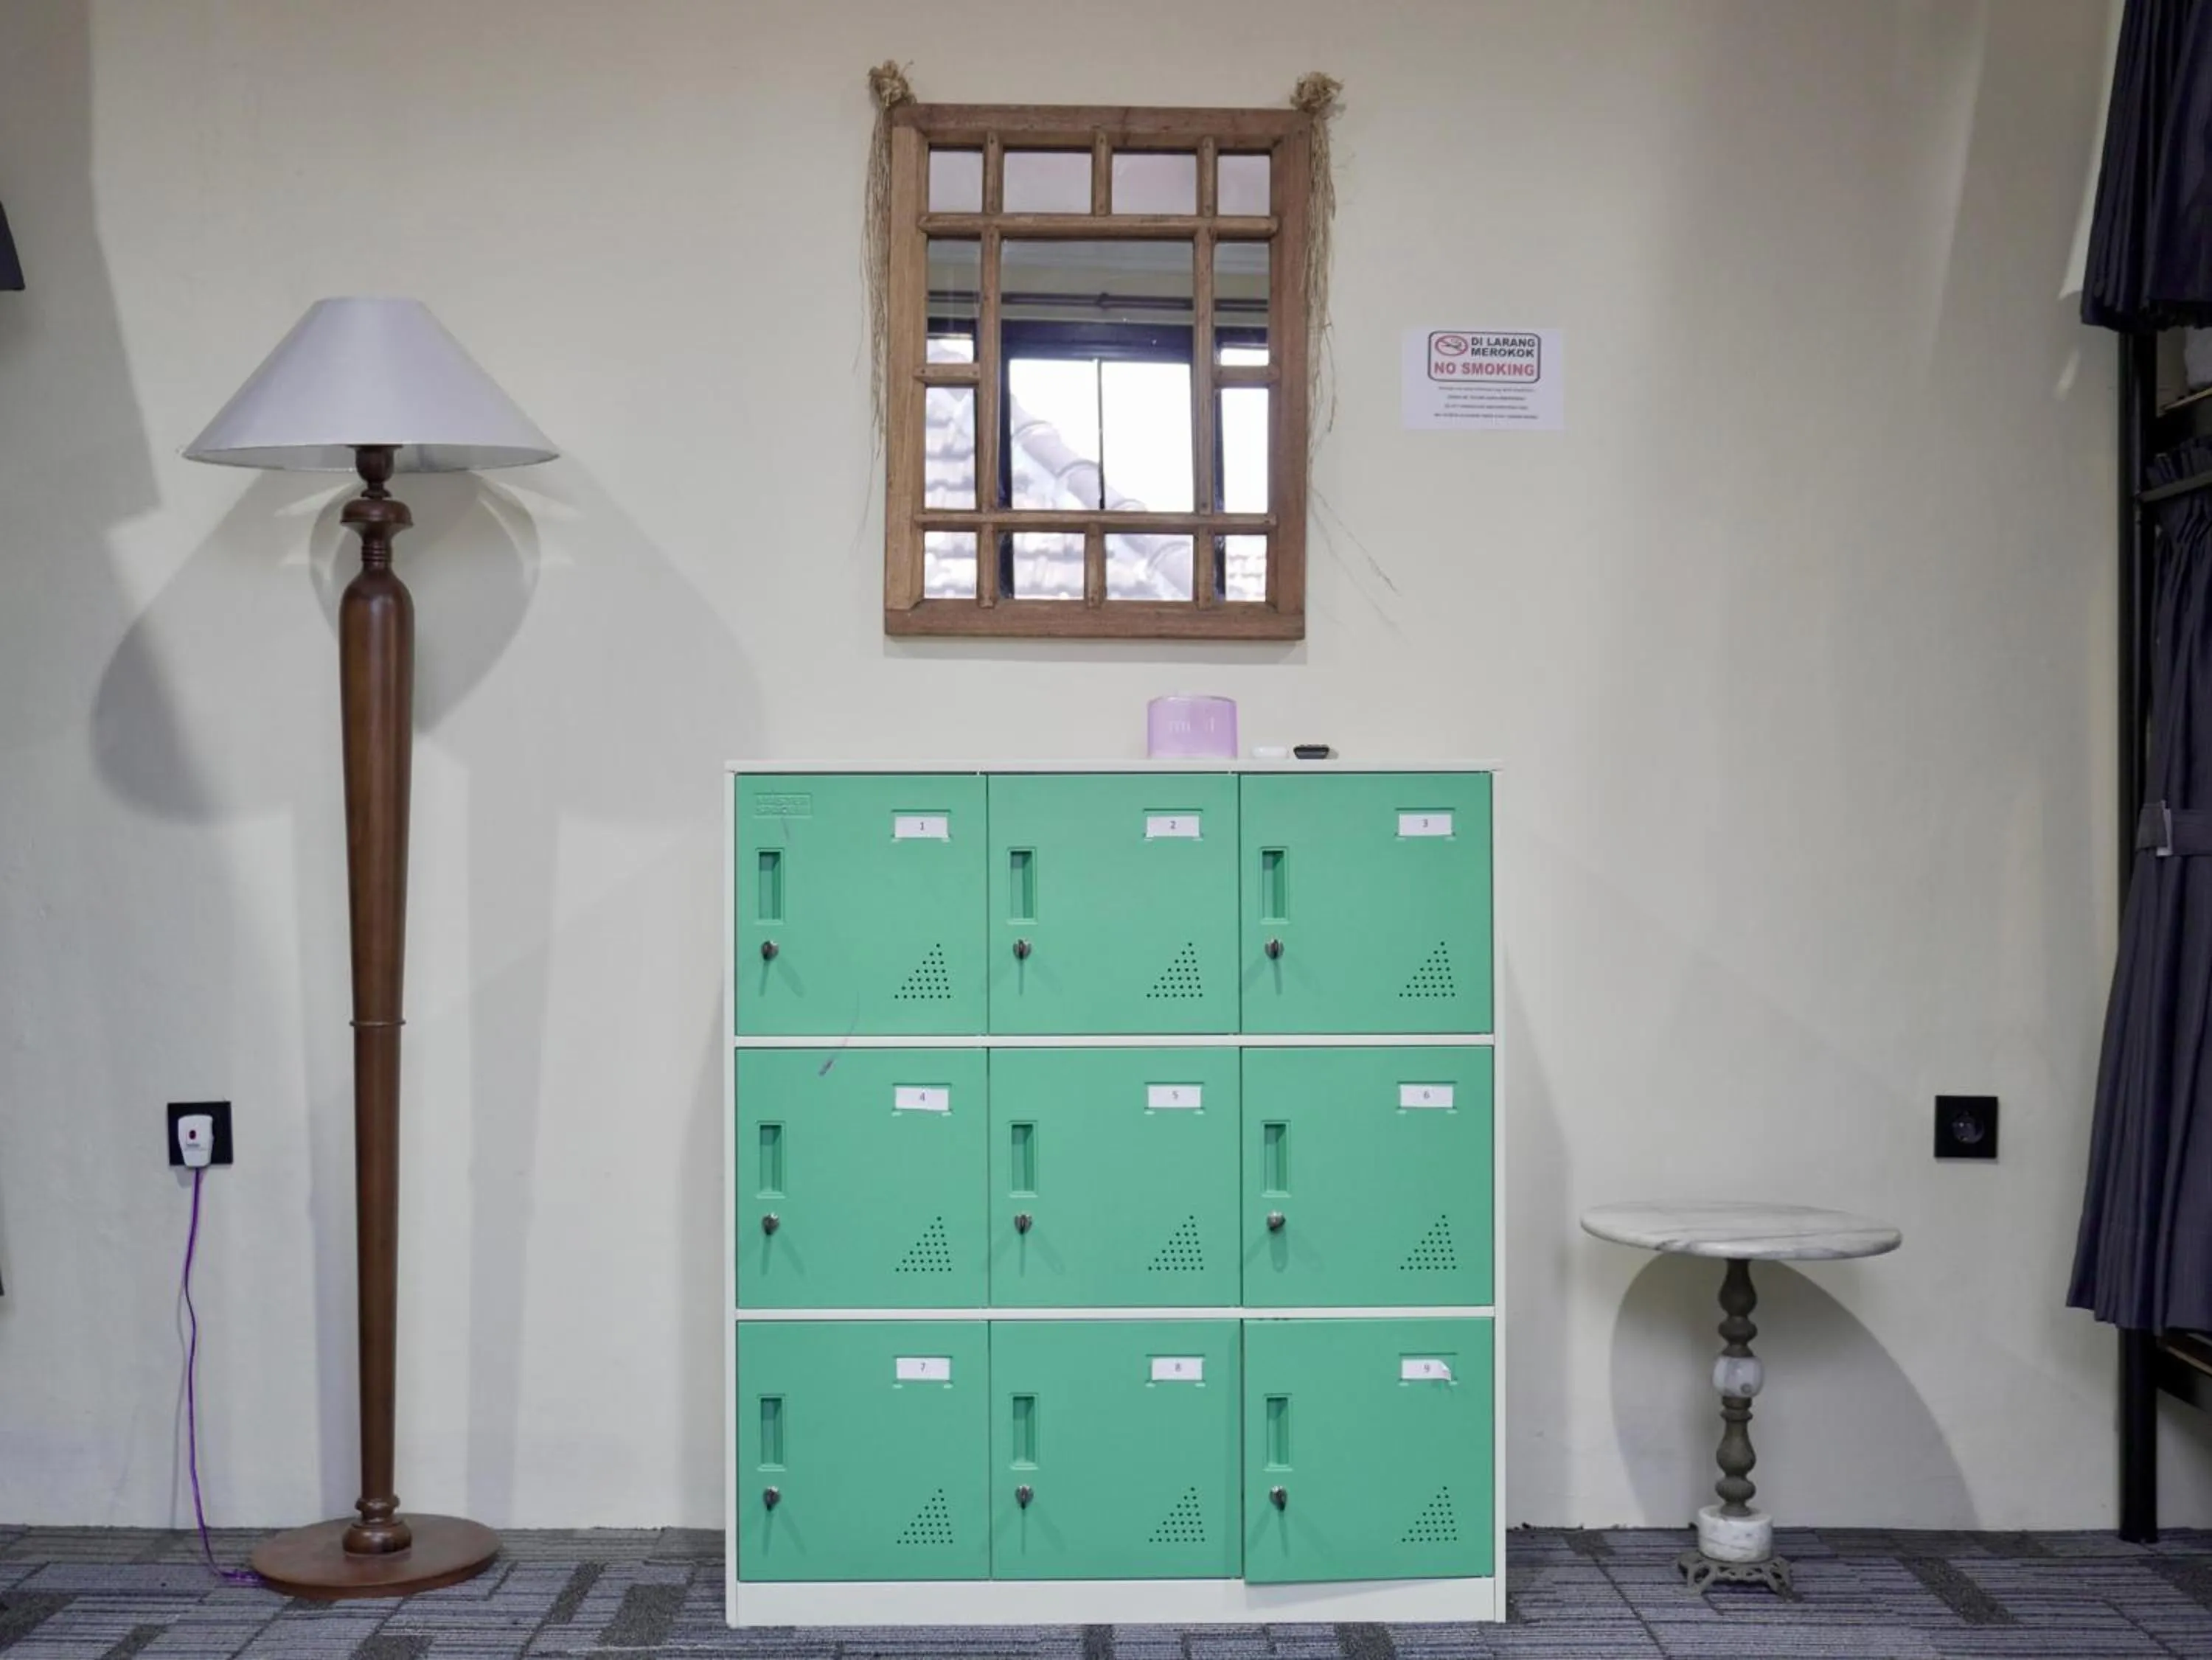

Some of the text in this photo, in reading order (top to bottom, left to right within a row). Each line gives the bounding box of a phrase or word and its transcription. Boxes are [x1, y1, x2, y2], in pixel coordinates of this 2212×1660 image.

[1470, 337, 1536, 348] DI LARANG
[1470, 347, 1535, 358] MEROKOK
[1433, 361, 1535, 377] NO SMOKING
